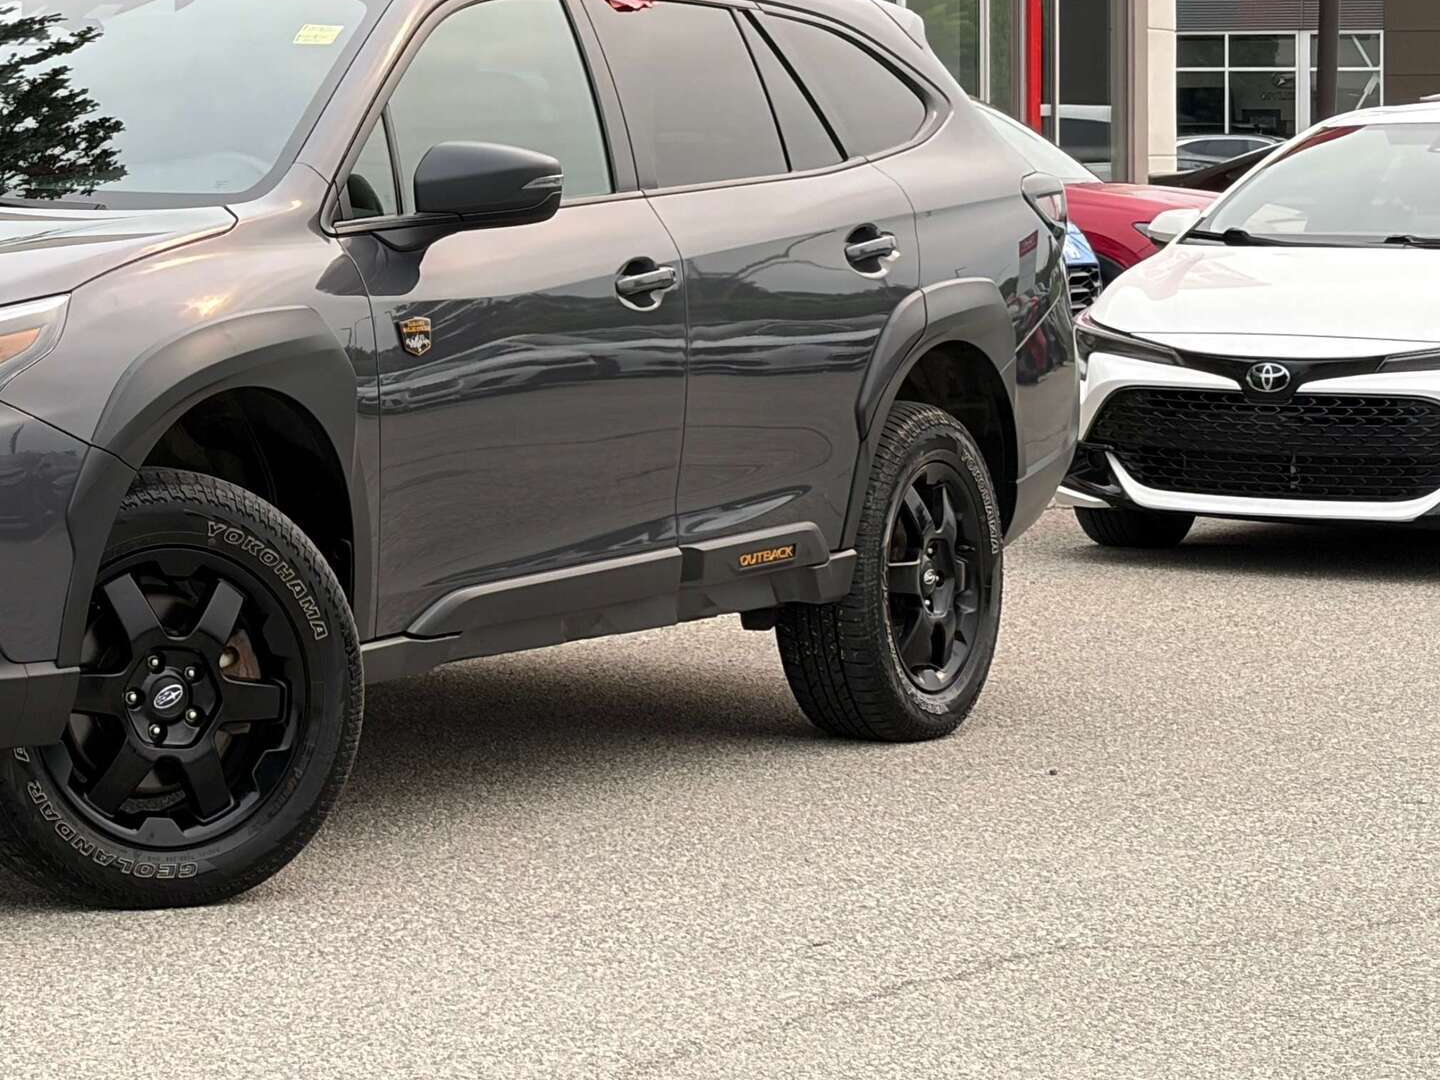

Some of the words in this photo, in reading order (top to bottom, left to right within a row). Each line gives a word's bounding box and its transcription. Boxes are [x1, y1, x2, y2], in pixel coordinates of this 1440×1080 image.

[207, 520, 329, 641] YOKOHAMA
[739, 545, 794, 566] OUTBACK
[26, 778, 199, 879] GEOLANDAR
